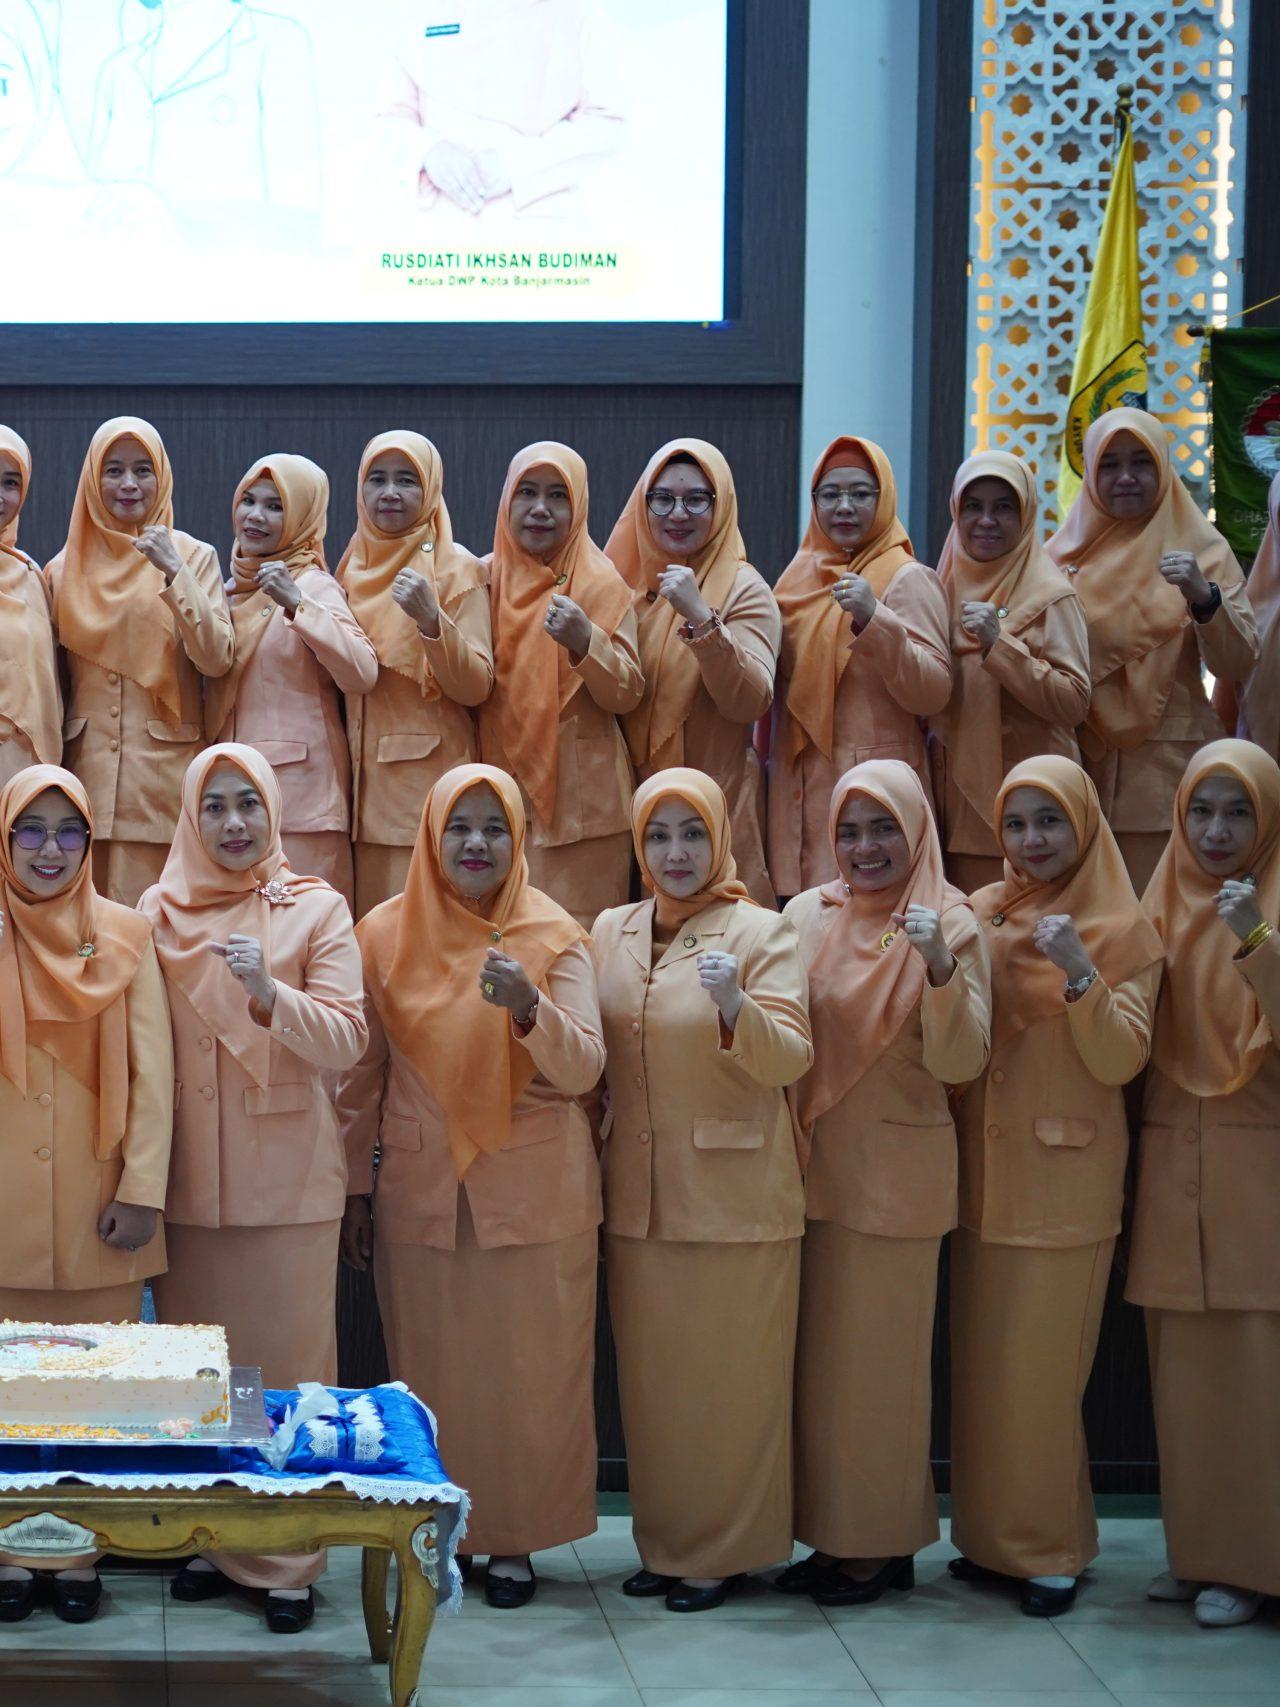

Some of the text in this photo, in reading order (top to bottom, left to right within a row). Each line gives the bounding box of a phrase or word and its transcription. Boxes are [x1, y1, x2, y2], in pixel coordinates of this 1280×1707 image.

[381, 253, 617, 269] RUSDIATI IKHSAN BUDIMAN
[447, 275, 476, 287] DWP
[480, 275, 510, 287] Kota
[513, 275, 590, 289] Banjarmasin
